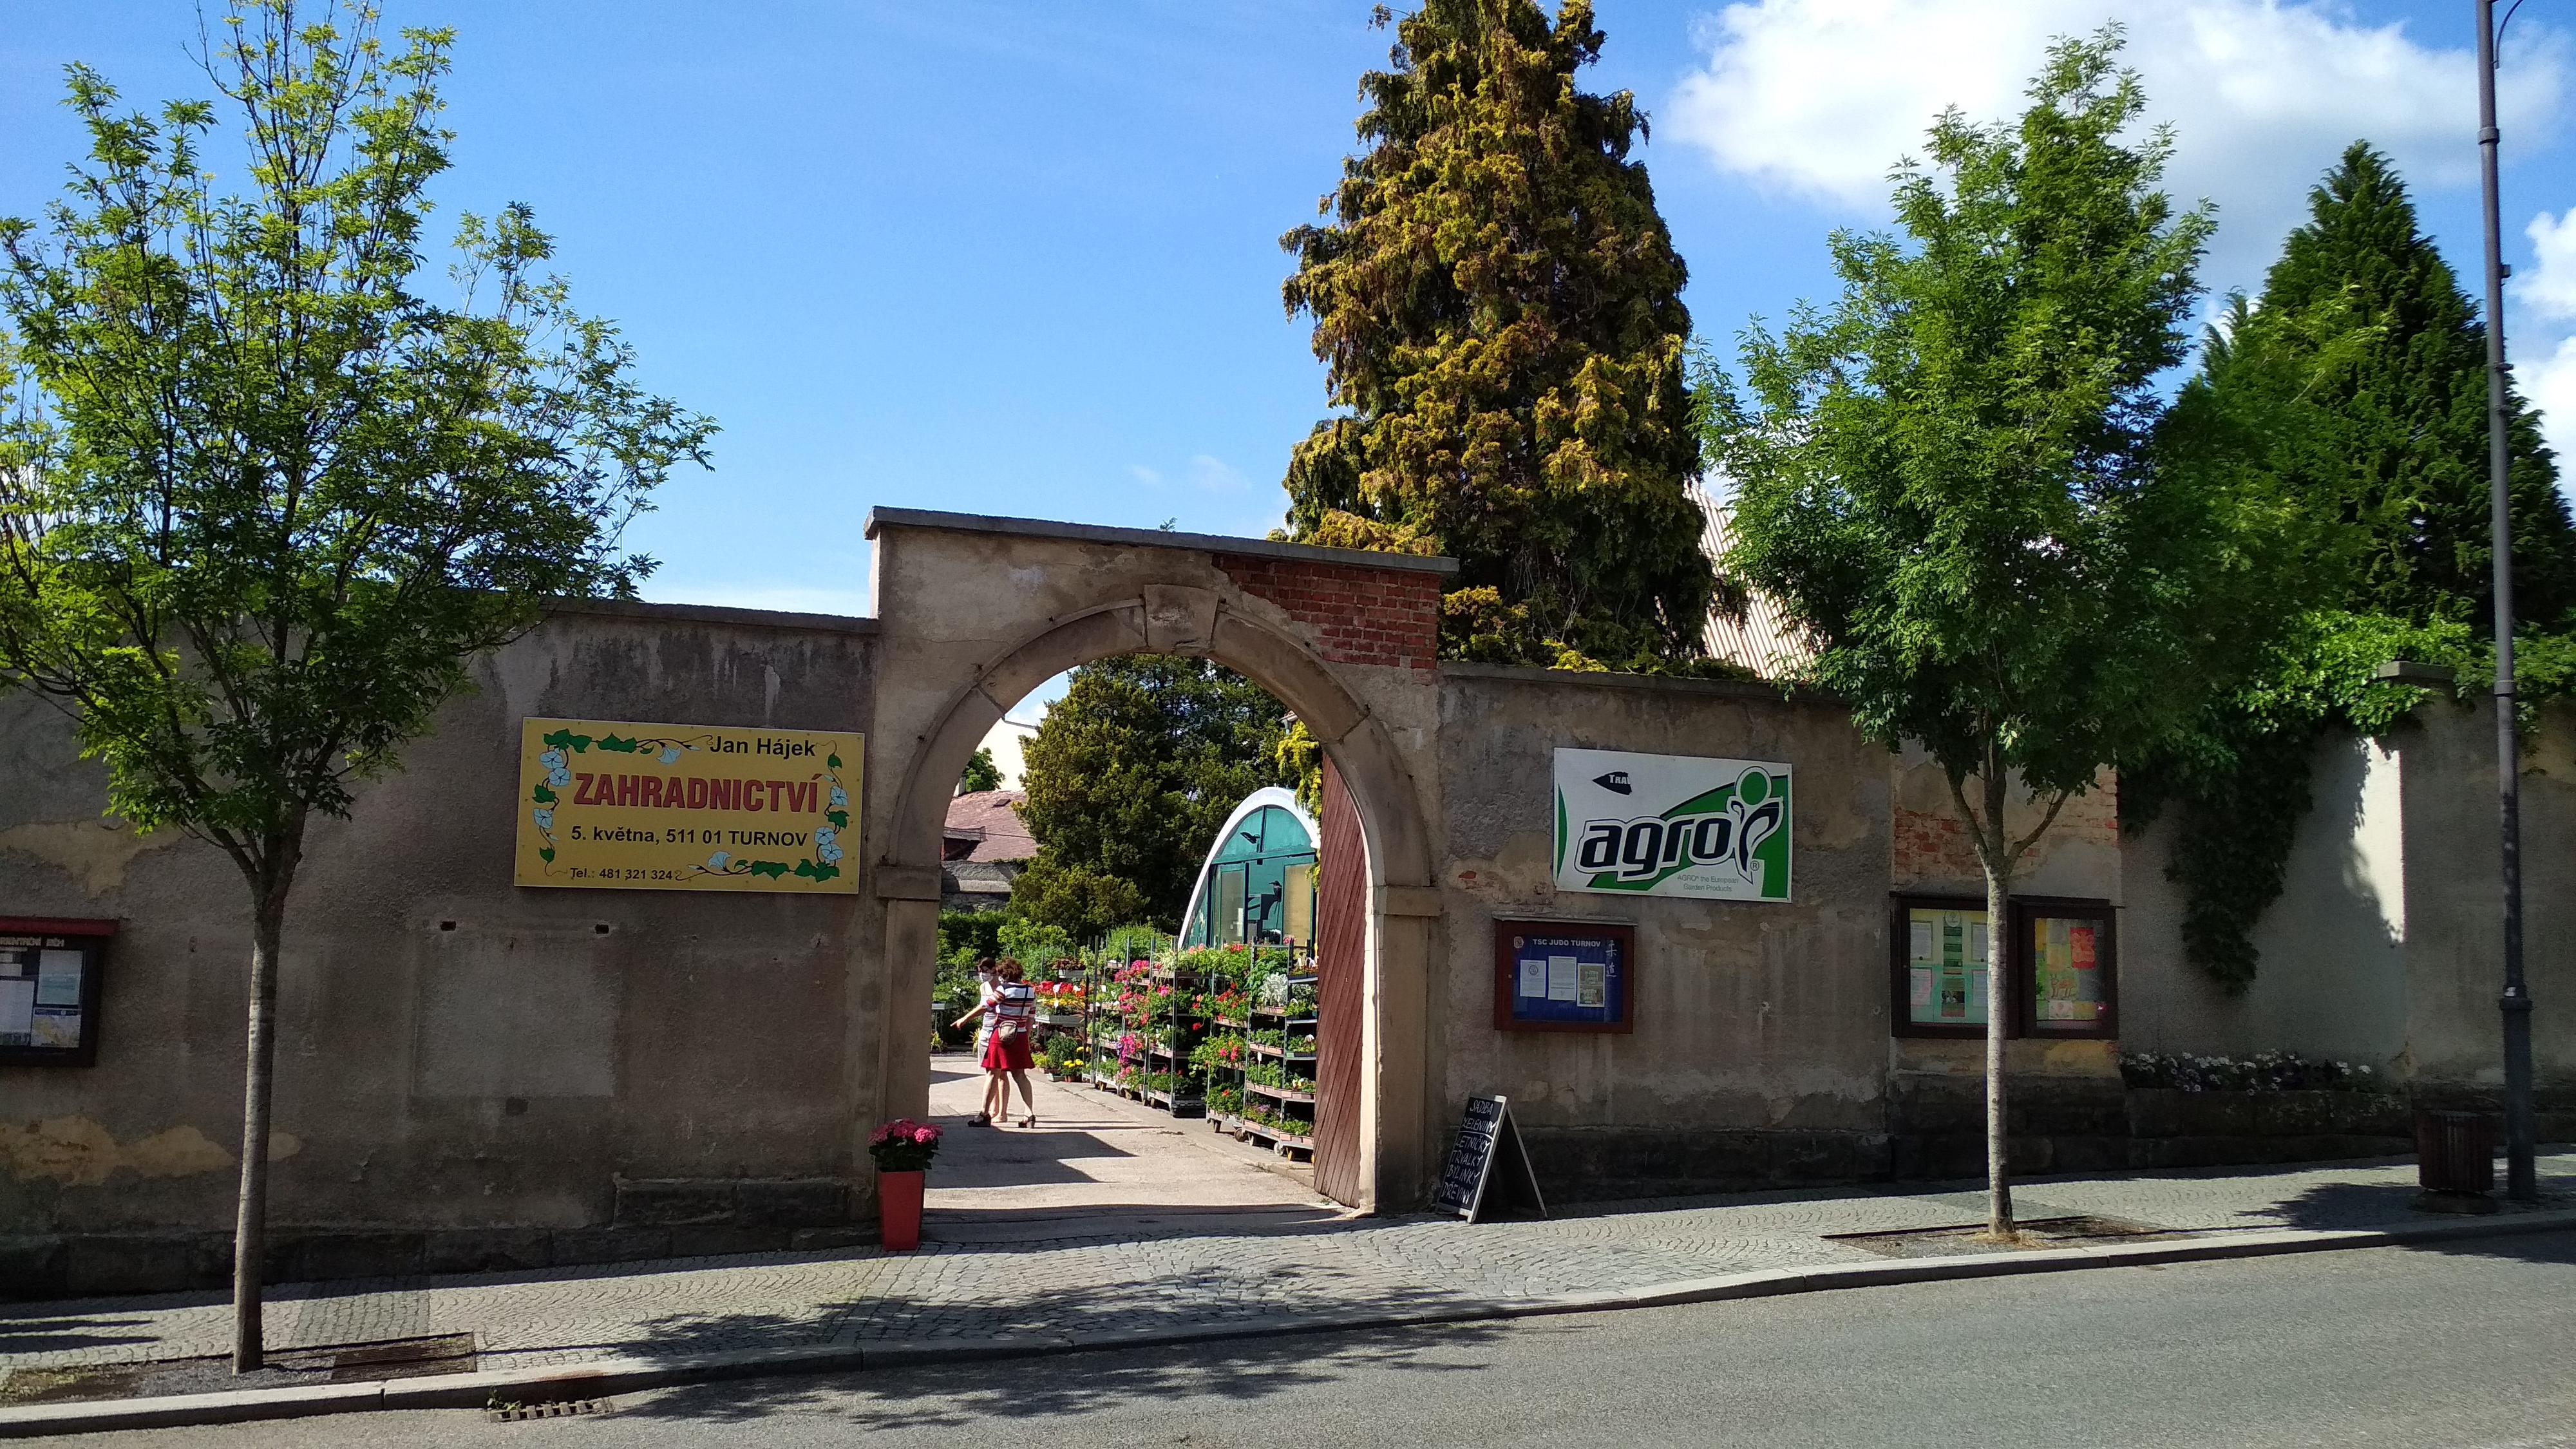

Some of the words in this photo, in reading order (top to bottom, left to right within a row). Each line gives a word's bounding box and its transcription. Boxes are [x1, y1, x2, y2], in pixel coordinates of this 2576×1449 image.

[709, 735, 748, 754] Jan
[757, 738, 817, 759] Hájek
[573, 773, 823, 813] ZAHRADNICTVÍ
[571, 825, 587, 841] 5.
[593, 826, 660, 846] května,
[666, 829, 695, 844] 511
[702, 830, 722, 845] 01
[728, 830, 808, 847] TURNOV
[569, 867, 595, 879] Tel.:
[599, 867, 620, 879] 481
[625, 868, 647, 880] 321
[651, 868, 673, 880] 324
[1470, 1100, 1493, 1115] SADBA
[1455, 1134, 1490, 1153] LETNIČKY
[1452, 1150, 1483, 1167] TRVALKY
[1446, 1164, 1480, 1185] BYLINKY
[1441, 1181, 1473, 1205] DŘEVINY
